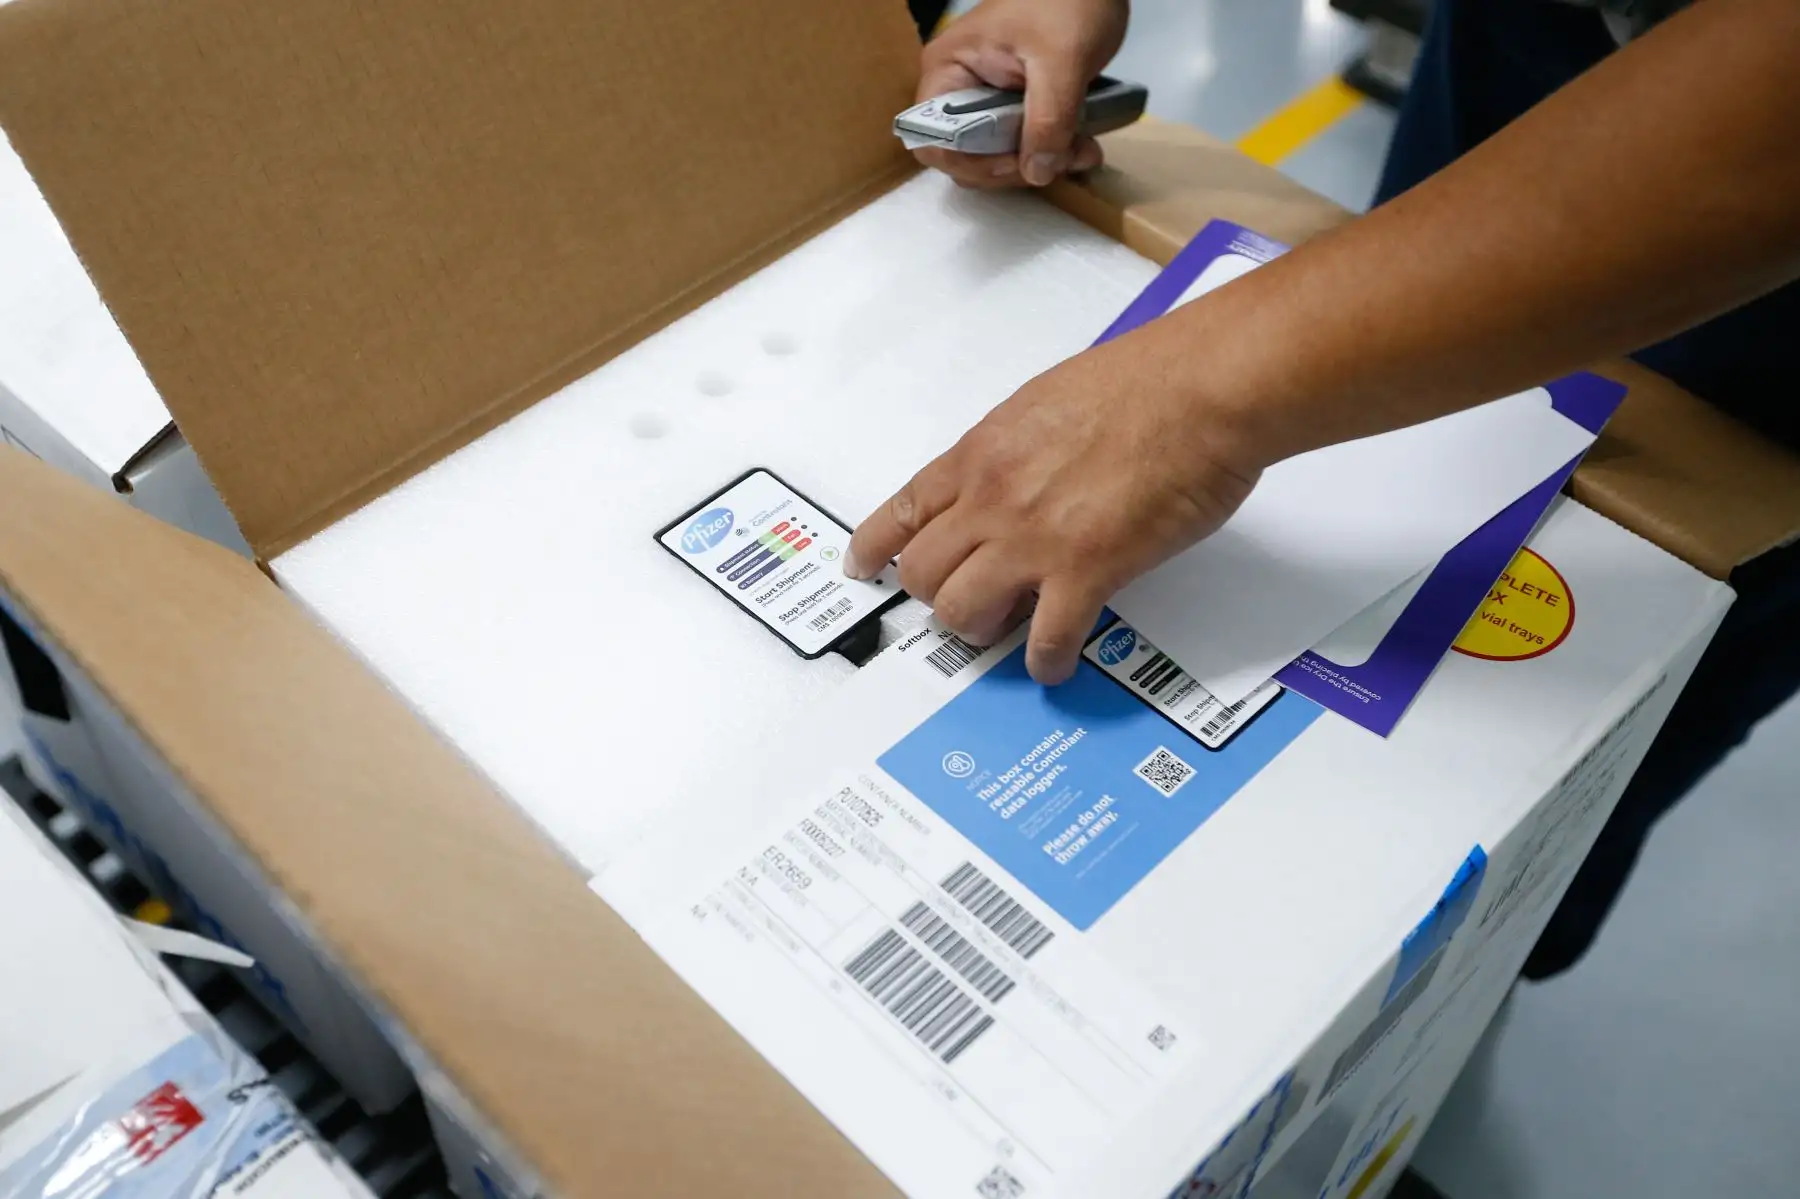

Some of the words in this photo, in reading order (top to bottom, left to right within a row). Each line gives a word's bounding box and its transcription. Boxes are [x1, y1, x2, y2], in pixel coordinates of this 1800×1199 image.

[683, 510, 732, 550] Pfizer
[735, 558, 761, 576] Connection
[745, 572, 764, 585] Battery
[755, 588, 778, 604] Start
[776, 562, 814, 589] Shipment
[778, 607, 799, 622] Stop
[797, 581, 836, 608] Shipment
[1481, 611, 1508, 628] vial
[1509, 623, 1545, 645] trays
[898, 628, 932, 652] Softbox
[1100, 631, 1133, 662] Pfizer
[1301, 664, 1312, 673] Ice
[1311, 660, 1339, 677] placing
[1313, 671, 1327, 680] Dry
[1329, 678, 1341, 688] the
[1340, 676, 1349, 685] by
[1164, 693, 1180, 706] Start
[1343, 687, 1370, 704] Ensure
[1350, 683, 1381, 700] covered
[1184, 709, 1198, 721] Stop
[977, 783, 1001, 800] This
[997, 765, 1022, 784] box
[1021, 730, 1063, 766] contains
[990, 772, 1035, 810] reusable
[1033, 728, 1086, 772] Controlant
[1001, 797, 1026, 819] data
[1023, 765, 1066, 799] loggers.
[1043, 824, 1080, 855] Please
[1078, 811, 1095, 826] do
[1093, 795, 1113, 813] not
[1055, 835, 1087, 864] throw
[1087, 812, 1117, 837] away.
